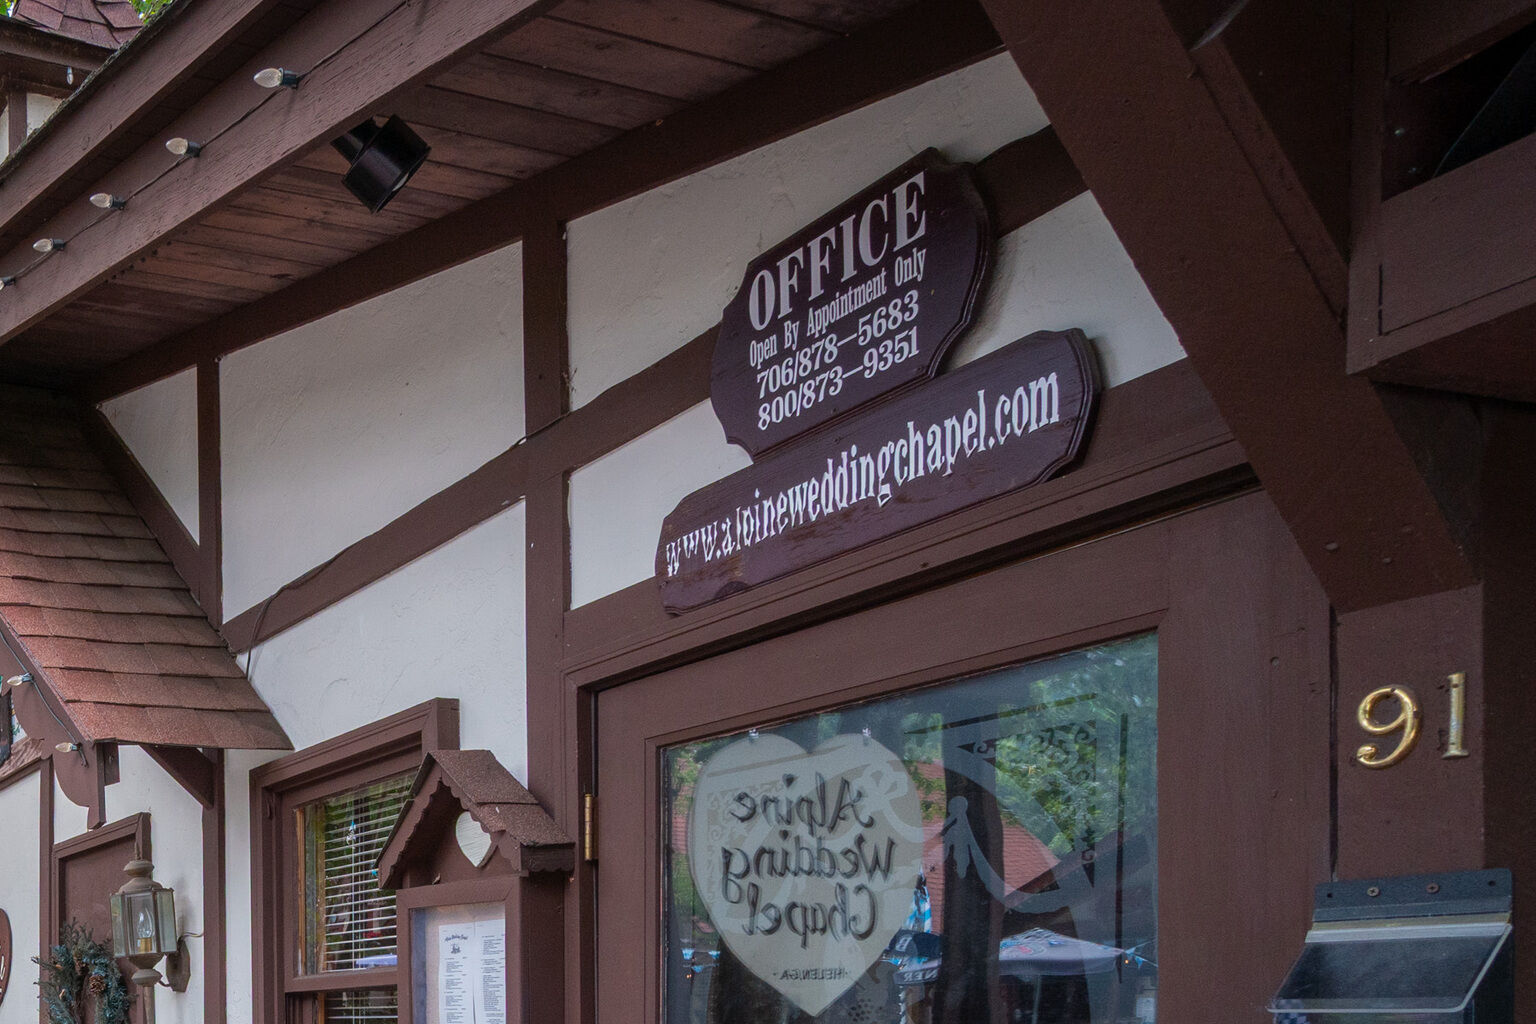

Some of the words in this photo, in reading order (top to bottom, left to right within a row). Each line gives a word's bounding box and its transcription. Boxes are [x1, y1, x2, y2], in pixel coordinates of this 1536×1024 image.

[749, 171, 927, 331] OFFICE
[750, 333, 777, 367] Open
[784, 320, 800, 350] By
[807, 267, 887, 337] Appointment
[895, 248, 927, 287] Only
[757, 289, 920, 399] 706/878-5683
[758, 326, 920, 431] 800/873-9351
[666, 372, 1060, 577] www.alpineweddingchapel.com
[1357, 671, 1470, 770] 91
